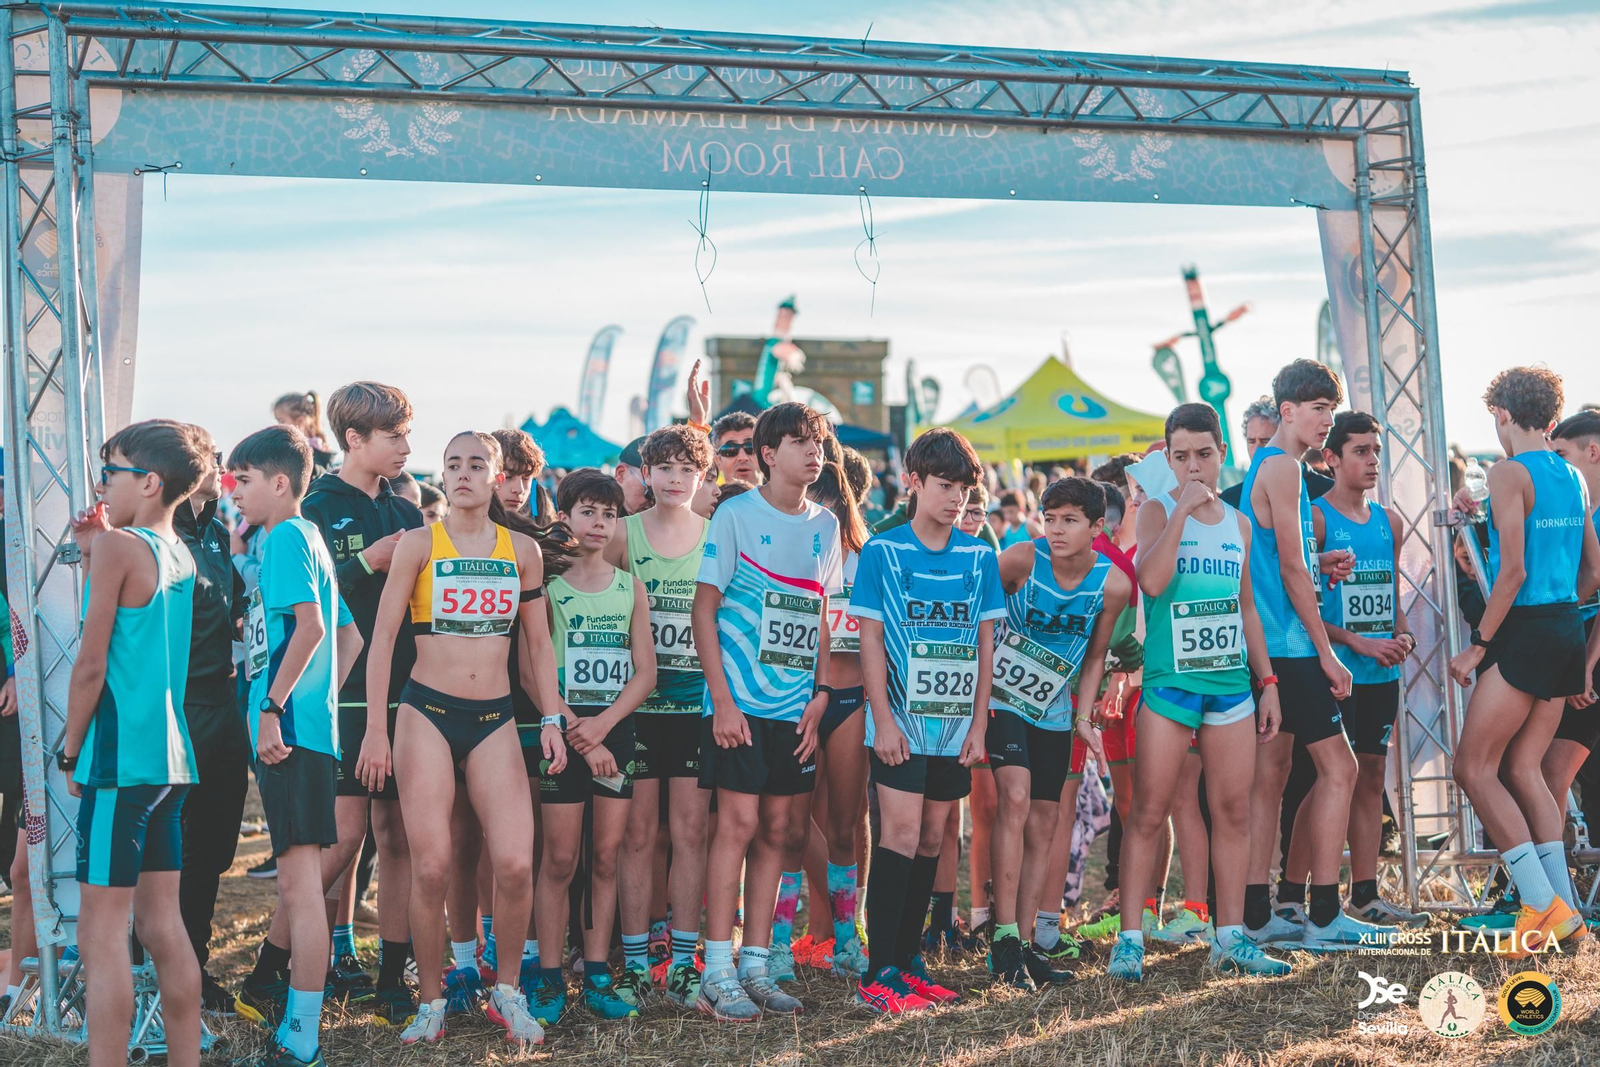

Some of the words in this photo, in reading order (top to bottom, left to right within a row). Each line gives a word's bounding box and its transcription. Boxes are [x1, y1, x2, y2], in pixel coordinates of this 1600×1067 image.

[459, 559, 499, 572] ITÁLICA
[1177, 557, 1200, 575] C.D
[1203, 557, 1240, 580] GILETE
[662, 578, 697, 587] Fundaci
[1360, 571, 1385, 580] ITÁLICA
[662, 586, 693, 597] Unicaja
[441, 588, 513, 615] 5285
[661, 597, 693, 609] ITÁLIC
[784, 595, 814, 609] ITÁLICA
[1194, 601, 1228, 613] ITÁLICA
[1349, 593, 1392, 617] 8034
[586, 613, 627, 623] Fundación
[906, 600, 971, 622] CAR
[587, 621, 618, 631] Unicaja
[1025, 607, 1086, 632] CAR
[590, 632, 624, 644] ITÁLICA
[767, 620, 818, 651] 5920
[1181, 625, 1238, 653] 5867
[932, 643, 965, 656] ITÁLICA
[1022, 640, 1055, 666] ITÁLICA
[573, 659, 629, 685] 8041
[916, 670, 974, 697] 5828
[992, 656, 1054, 703] 5928
[425, 704, 447, 715] FASTER
